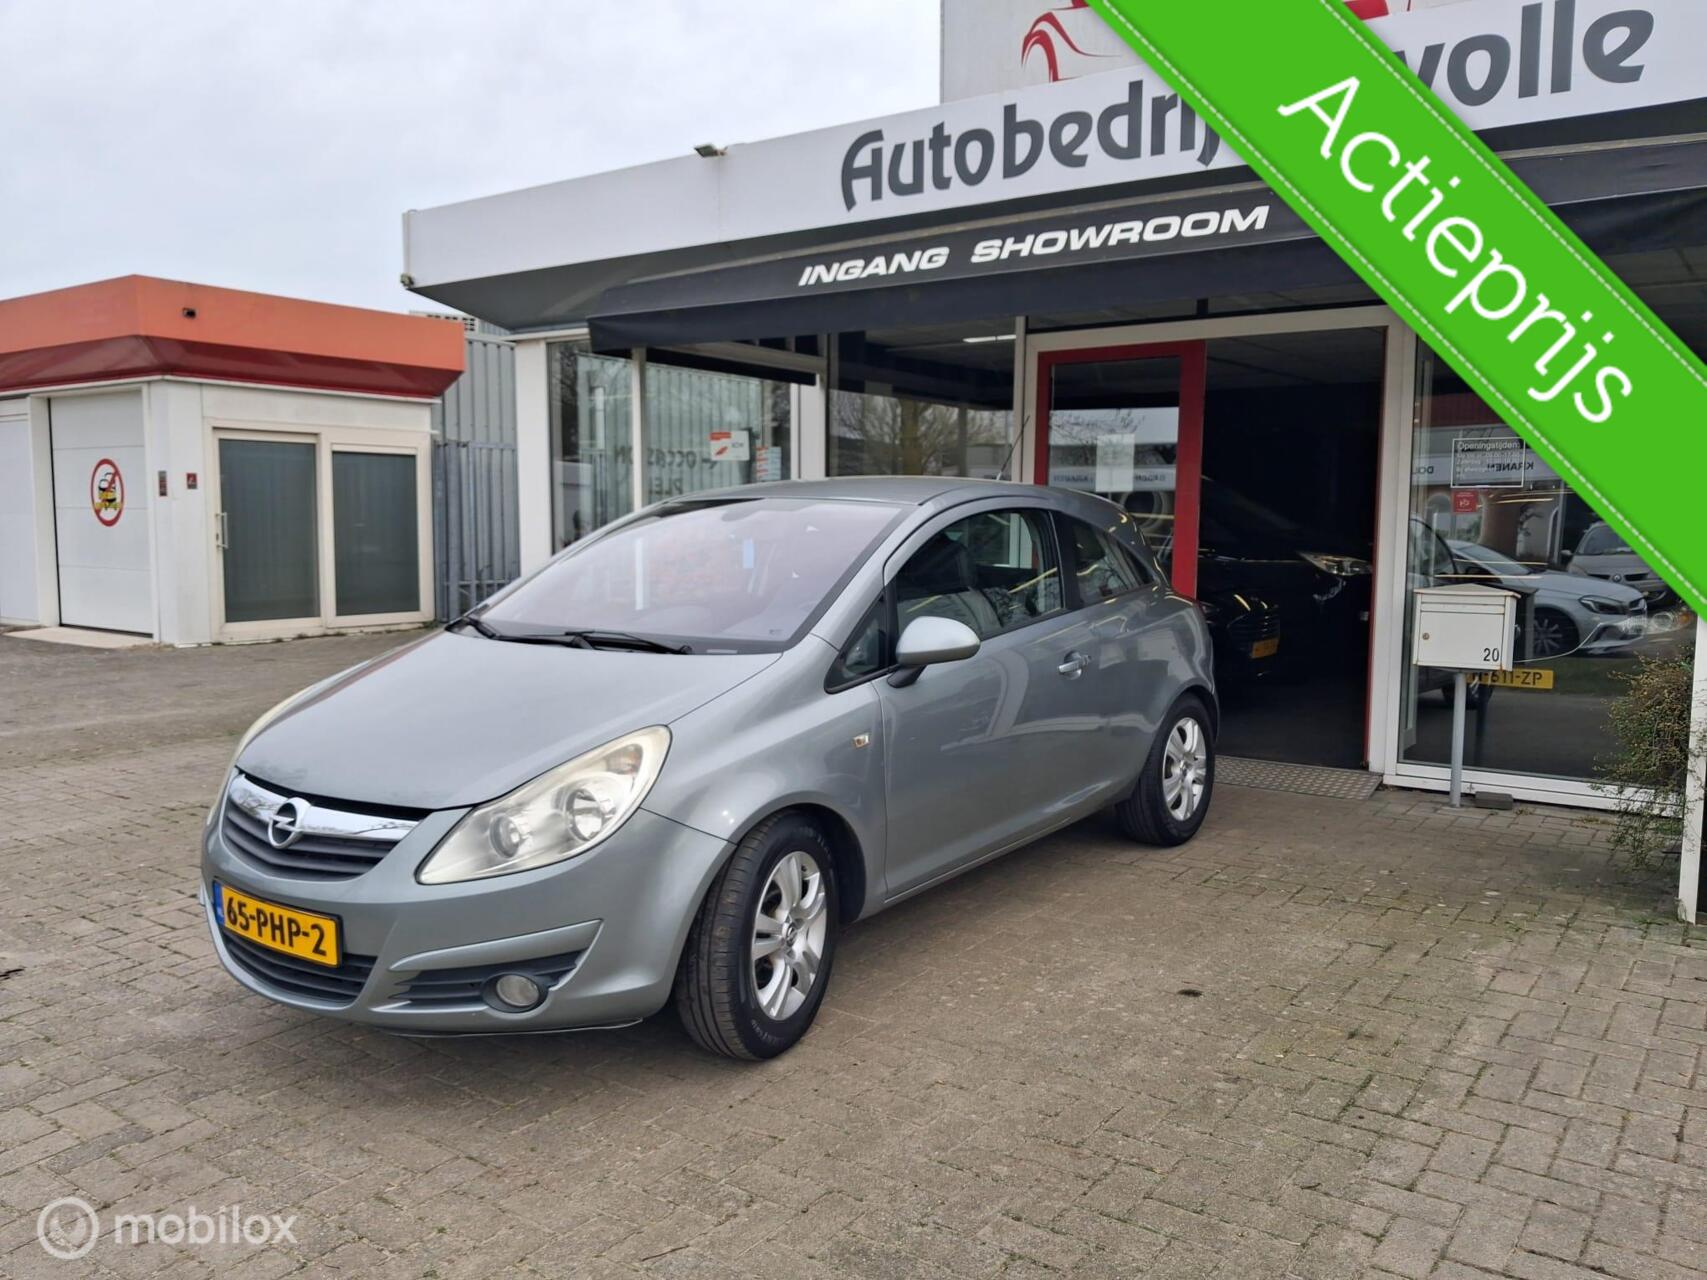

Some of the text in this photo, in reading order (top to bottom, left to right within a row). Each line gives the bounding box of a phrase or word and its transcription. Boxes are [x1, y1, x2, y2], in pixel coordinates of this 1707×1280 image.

[841, 0, 1654, 211] Autobedrij olle
[799, 206, 1270, 286] INGANG SHOWROOM
[1483, 647, 1500, 662] 20
[226, 897, 327, 957] 65-PHP-2
